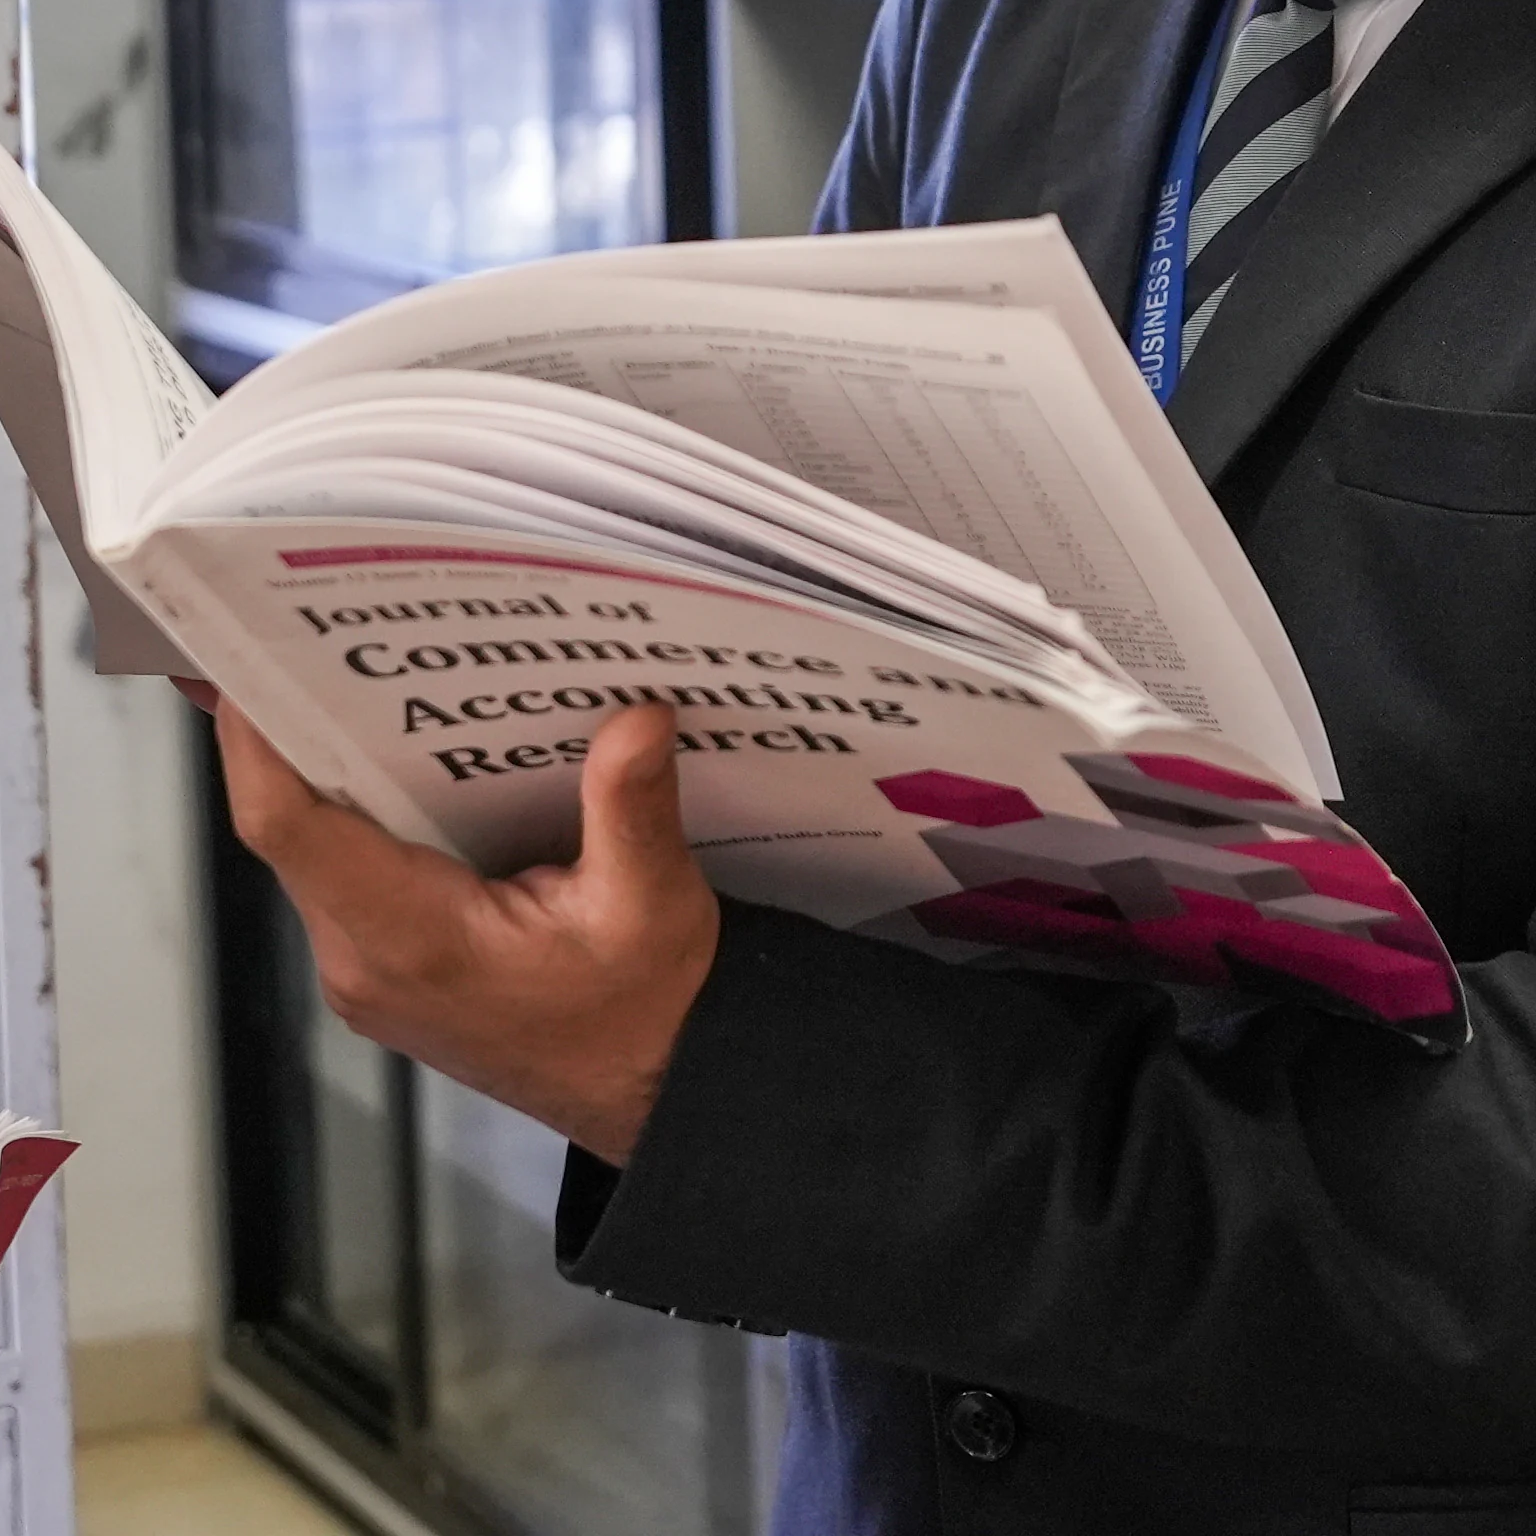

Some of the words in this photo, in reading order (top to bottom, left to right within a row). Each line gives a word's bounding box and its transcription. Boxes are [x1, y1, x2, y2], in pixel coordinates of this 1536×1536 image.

[1150, 177, 1184, 253] PUNE
[1138, 255, 1173, 393] BUSINESS
[296, 583, 572, 637] Journal
[586, 595, 659, 629] of
[343, 632, 847, 684] Commerce
[869, 663, 1053, 711] and
[401, 681, 923, 739] Accounting
[432, 721, 859, 785] Resarch
